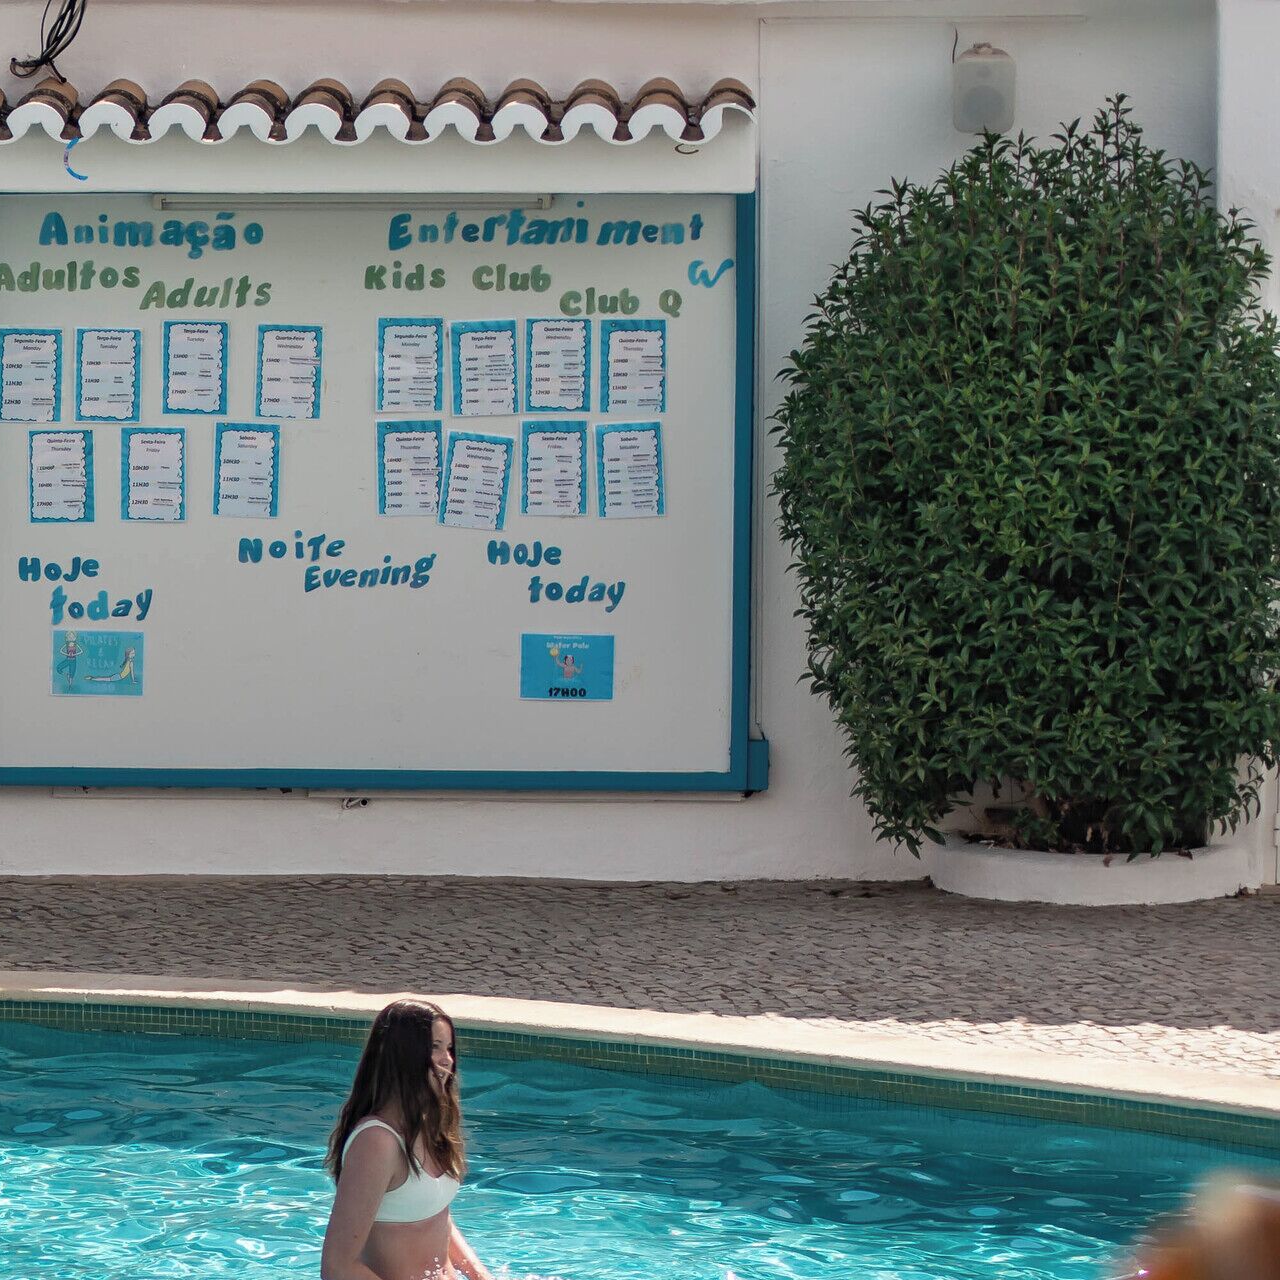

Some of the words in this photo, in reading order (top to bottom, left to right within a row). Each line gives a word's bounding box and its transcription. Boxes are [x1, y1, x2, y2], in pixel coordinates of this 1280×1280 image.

[39, 211, 264, 260] Animação
[139, 275, 272, 311] Adults
[364, 261, 446, 291] Kids
[472, 263, 552, 293] Club
[559, 287, 640, 317] Club
[659, 289, 683, 318] Q
[304, 552, 437, 593] Evening
[49, 585, 153, 625] today
[528, 575, 626, 613] today
[548, 687, 587, 697] 17H00
